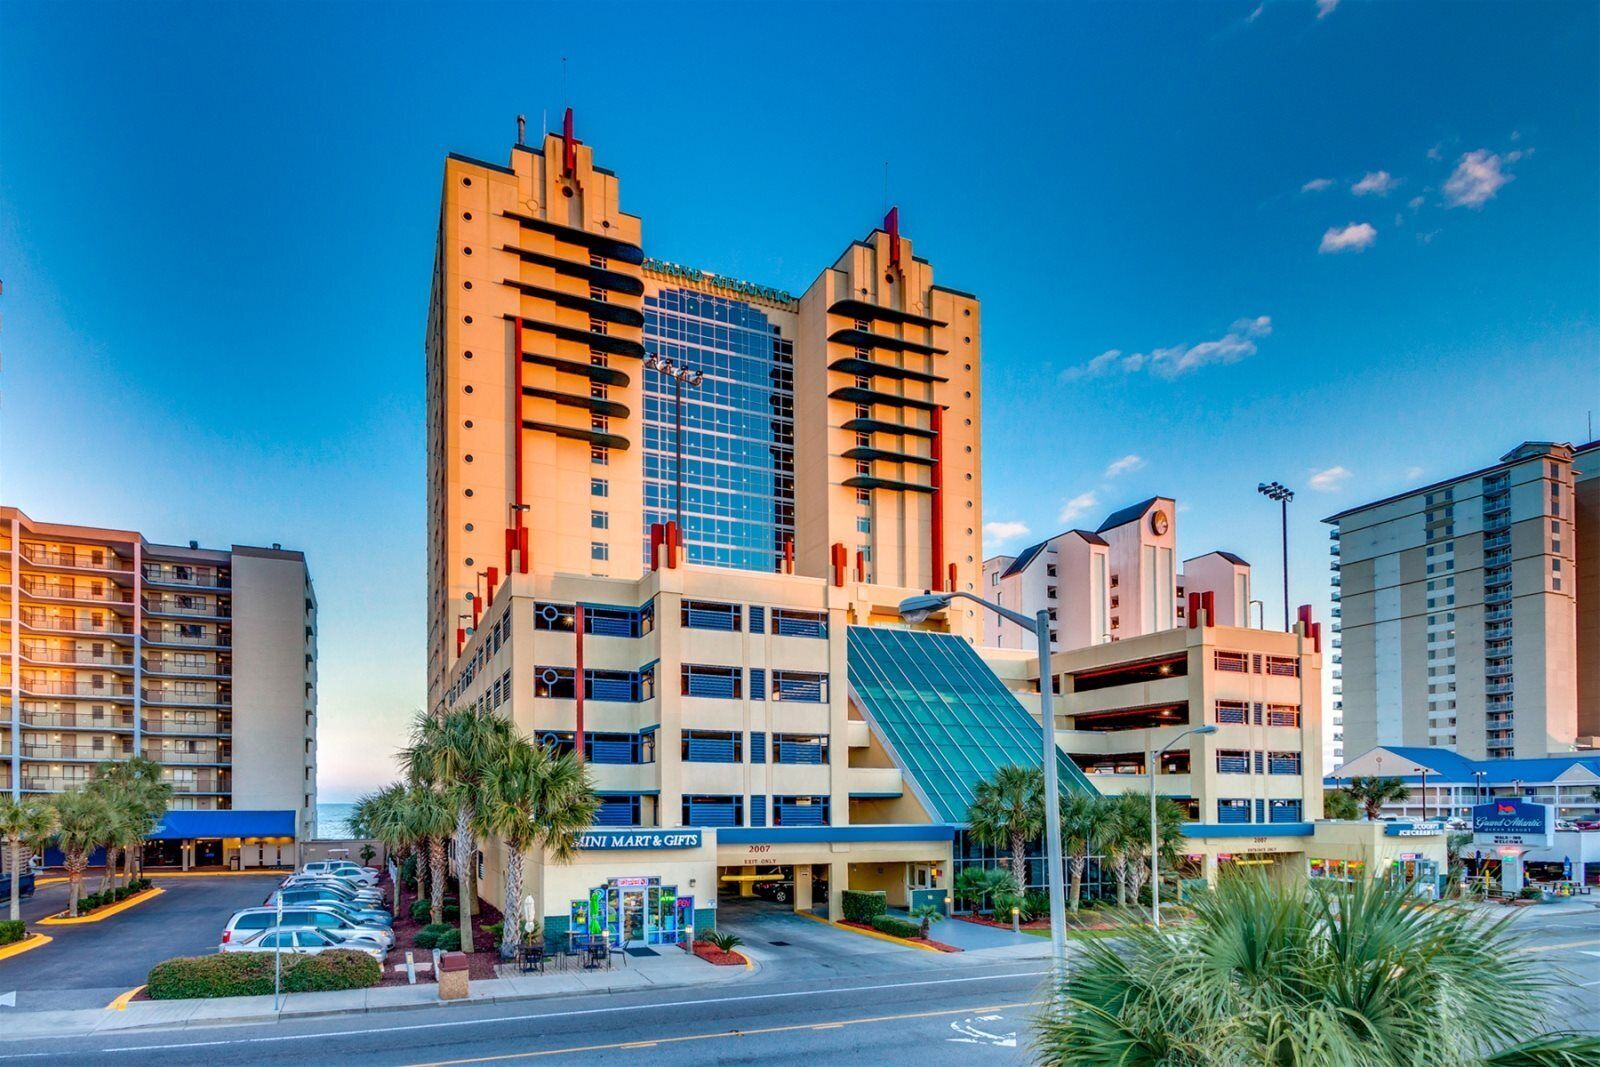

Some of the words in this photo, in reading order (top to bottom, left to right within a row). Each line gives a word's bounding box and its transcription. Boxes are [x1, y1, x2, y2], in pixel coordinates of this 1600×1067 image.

[710, 274, 791, 304] ATLANTIC
[1474, 816, 1504, 829] Grand
[1503, 816, 1542, 827] Atlantic
[611, 835, 652, 847] MART
[652, 835, 662, 847] &
[663, 834, 698, 846] GIFTS
[749, 845, 770, 853] 2007
